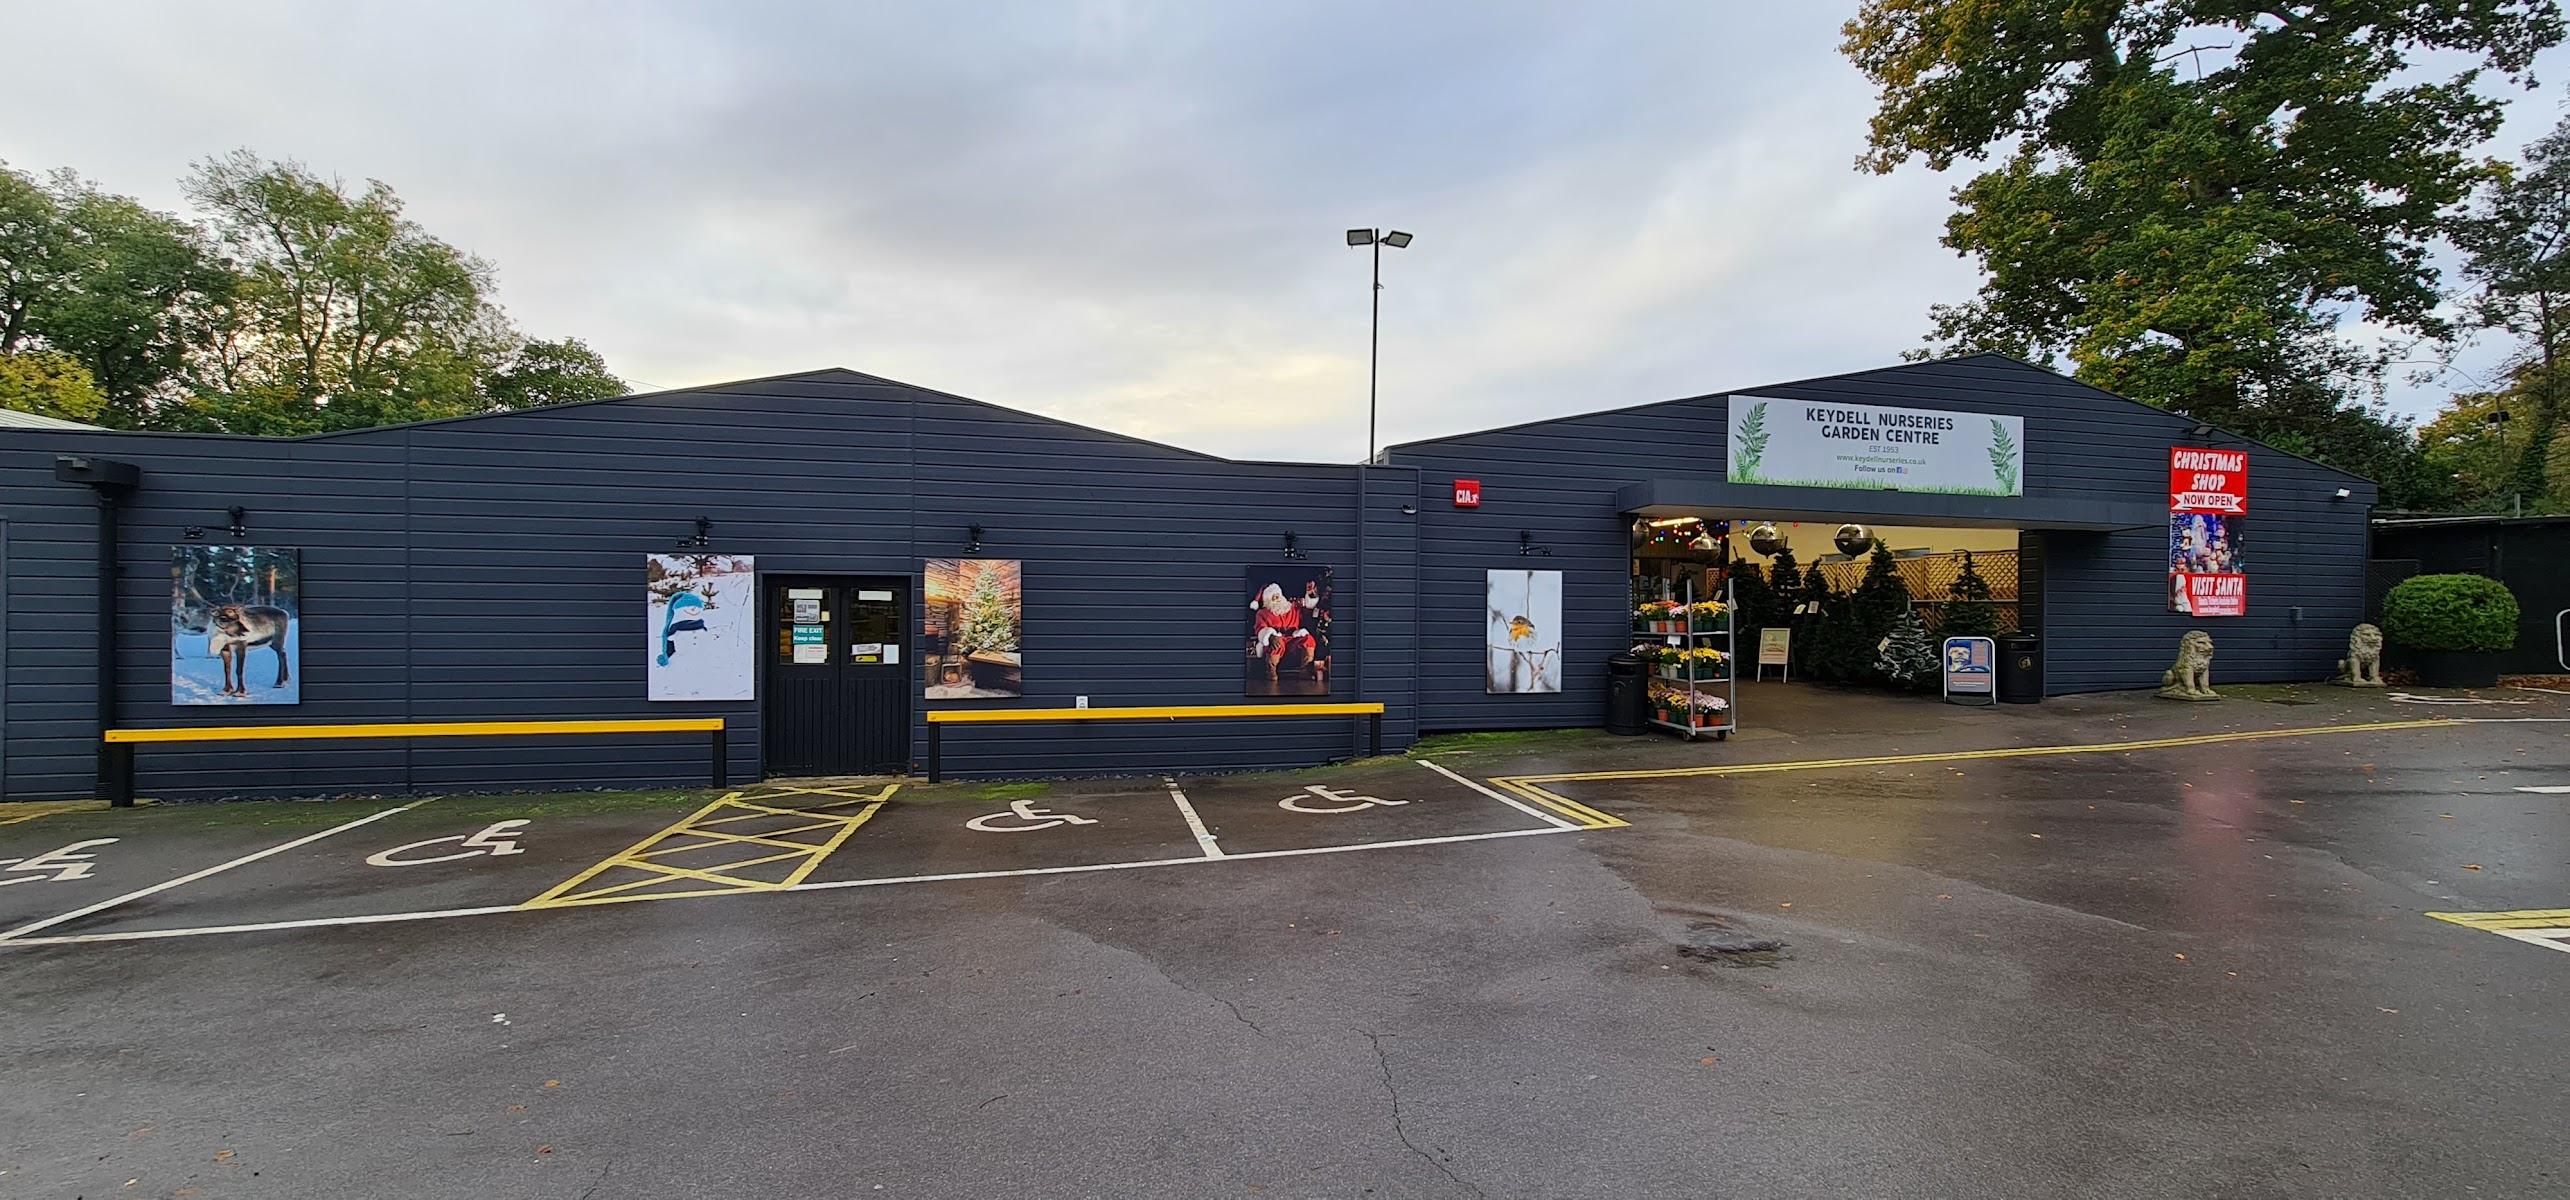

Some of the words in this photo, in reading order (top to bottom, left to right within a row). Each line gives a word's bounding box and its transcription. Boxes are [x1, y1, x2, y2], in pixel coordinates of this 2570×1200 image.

[1806, 407, 1871, 425] KEYDELL
[1878, 413, 1954, 431] NURSERIES
[1821, 424, 1880, 441] GARDEN
[1886, 429, 1940, 445] CENTRE
[1868, 445, 1881, 453] EST
[1882, 446, 1899, 454] 1953
[1836, 454, 1927, 466] www.keydellnurseries.co.uk
[1854, 464, 1876, 473] Follow
[2173, 450, 2244, 473] CHRISTMAS
[2191, 473, 2226, 492] SHOP
[2183, 494, 2206, 505] NOW
[2208, 495, 2233, 507] OPEN
[2191, 576, 2215, 596] VISIT
[2215, 576, 2243, 596] SANTA
